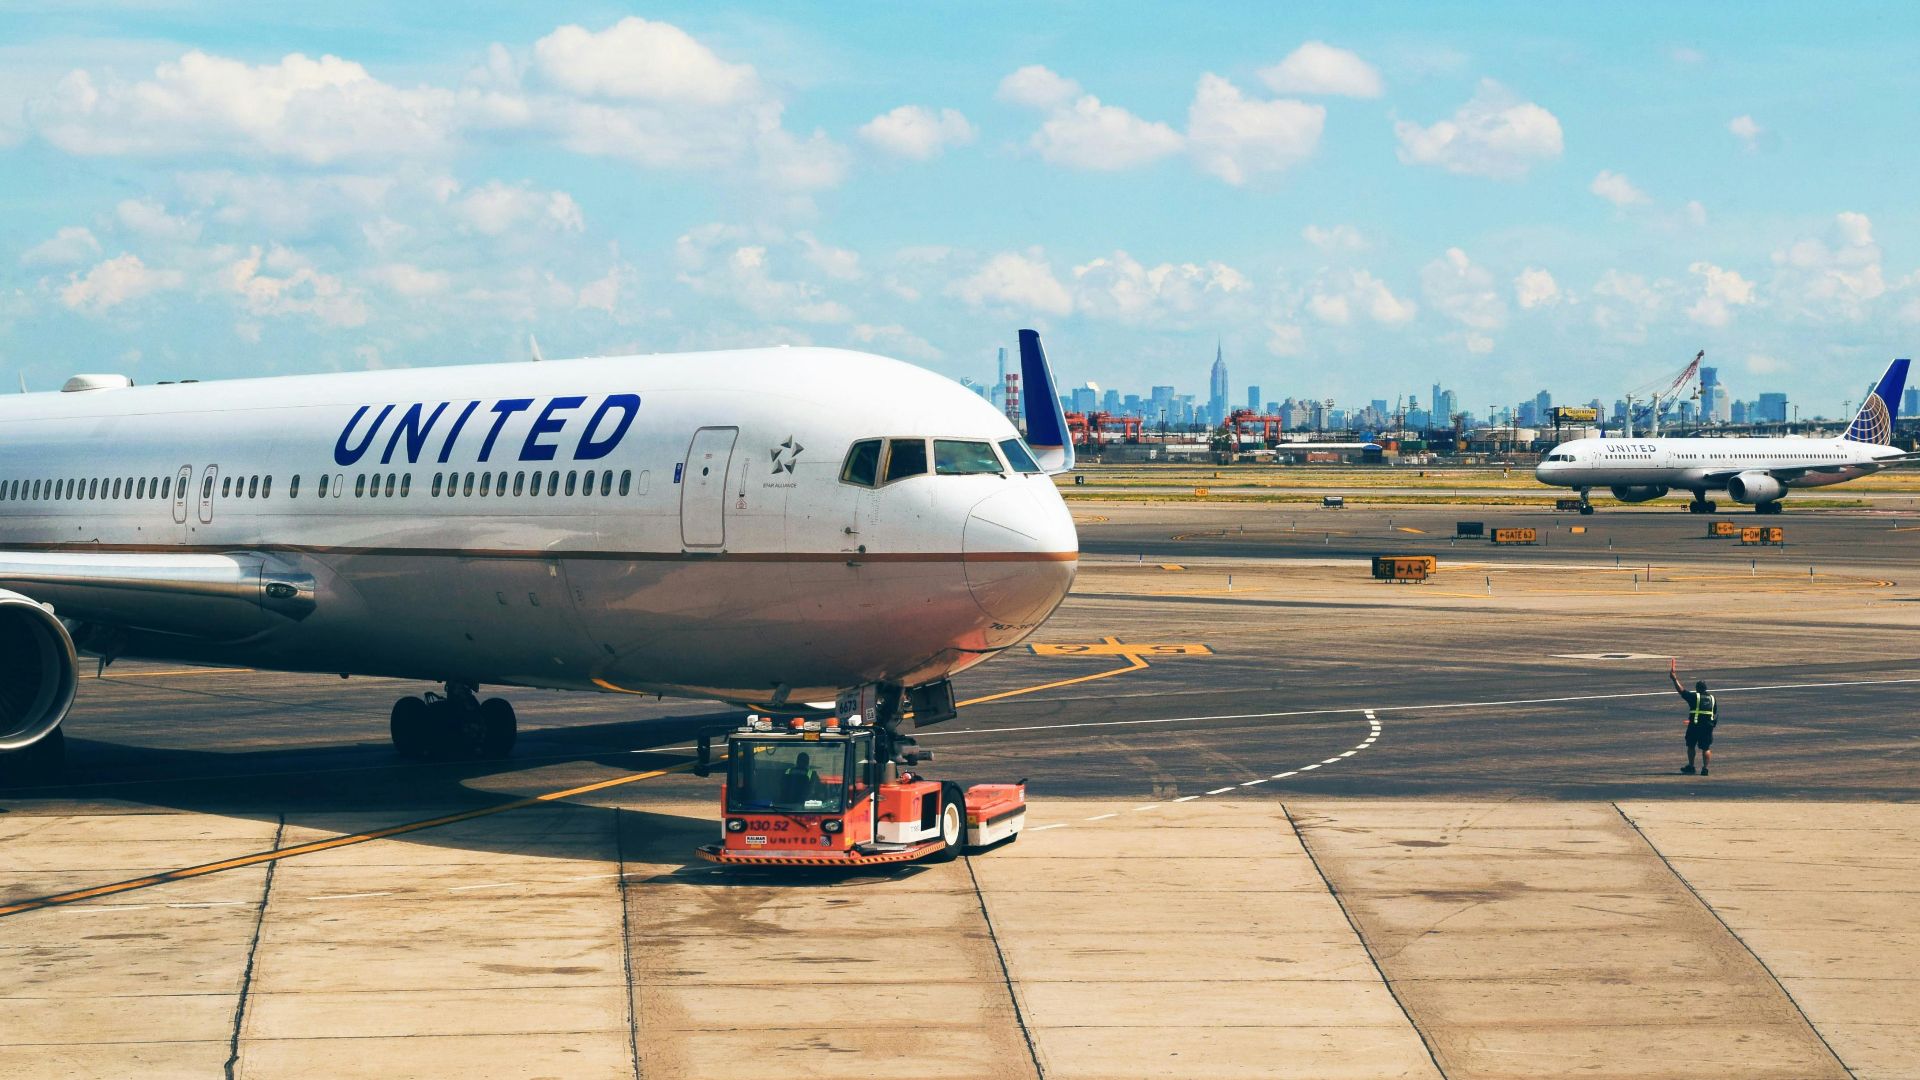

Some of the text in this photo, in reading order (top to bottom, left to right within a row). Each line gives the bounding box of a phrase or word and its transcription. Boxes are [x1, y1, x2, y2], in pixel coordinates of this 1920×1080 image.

[334, 393, 642, 466] UNITED
[1606, 444, 1656, 453] UNITED
[1505, 530, 1532, 539] GATE 63
[1380, 563, 1413, 575] RE A
[840, 699, 857, 714] 6673
